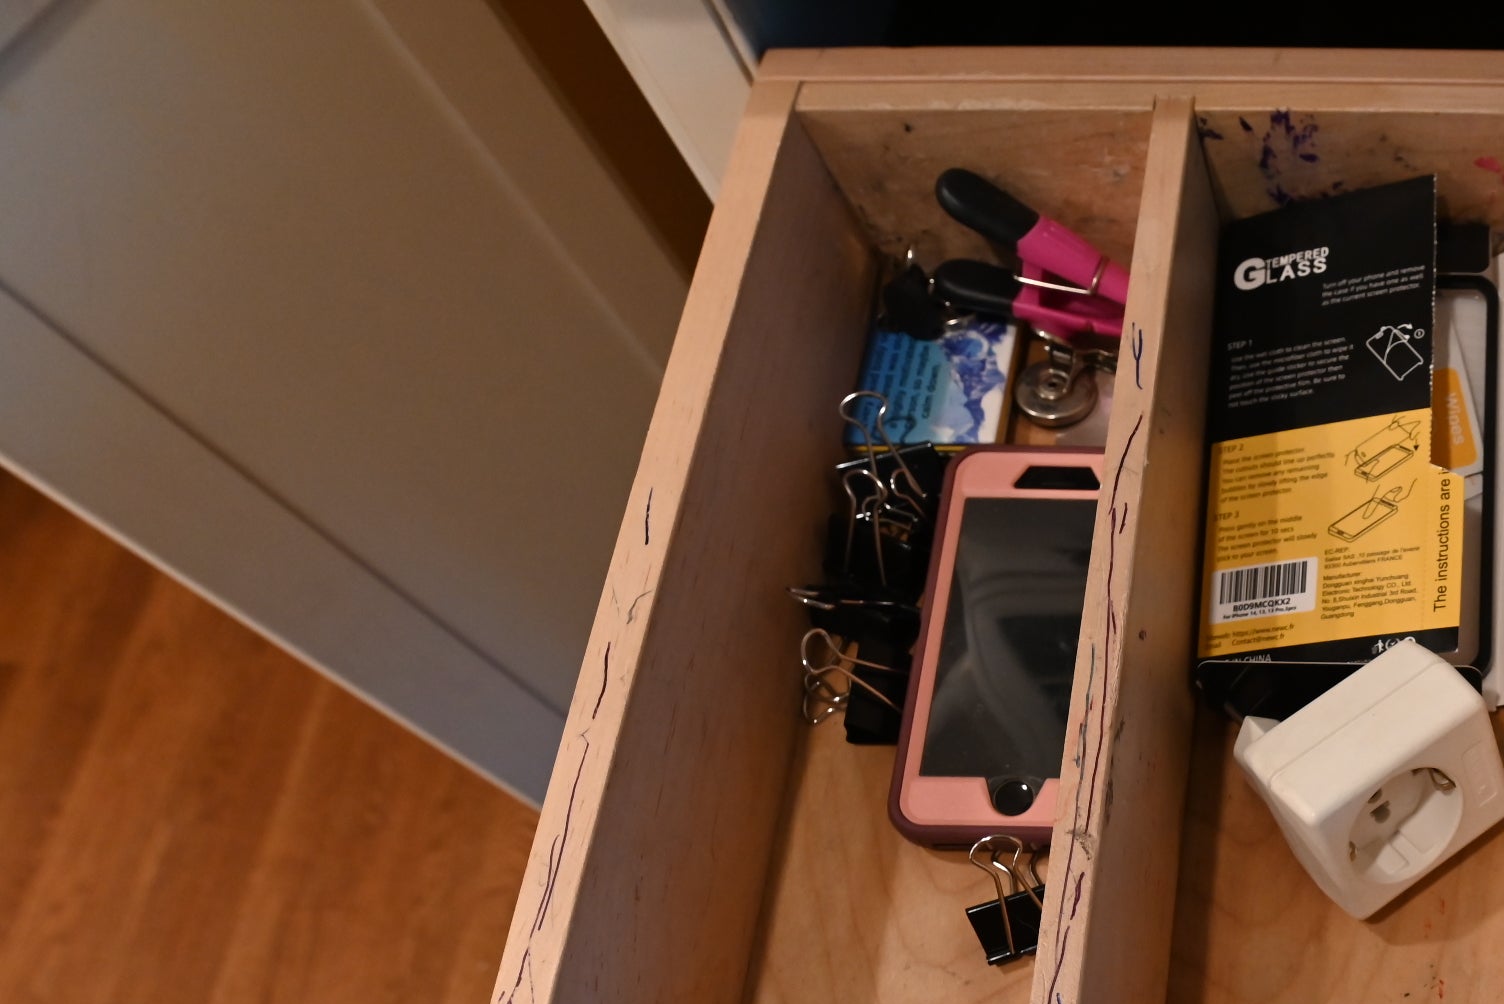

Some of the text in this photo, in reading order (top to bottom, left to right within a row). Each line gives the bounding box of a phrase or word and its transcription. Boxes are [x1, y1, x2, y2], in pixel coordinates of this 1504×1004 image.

[1266, 247, 1329, 267] TEMPERED
[1446, 391, 1466, 446] Wines
[1433, 477, 1451, 613] The instructions are
[1233, 598, 1290, 611] B0D9MCQKX2
